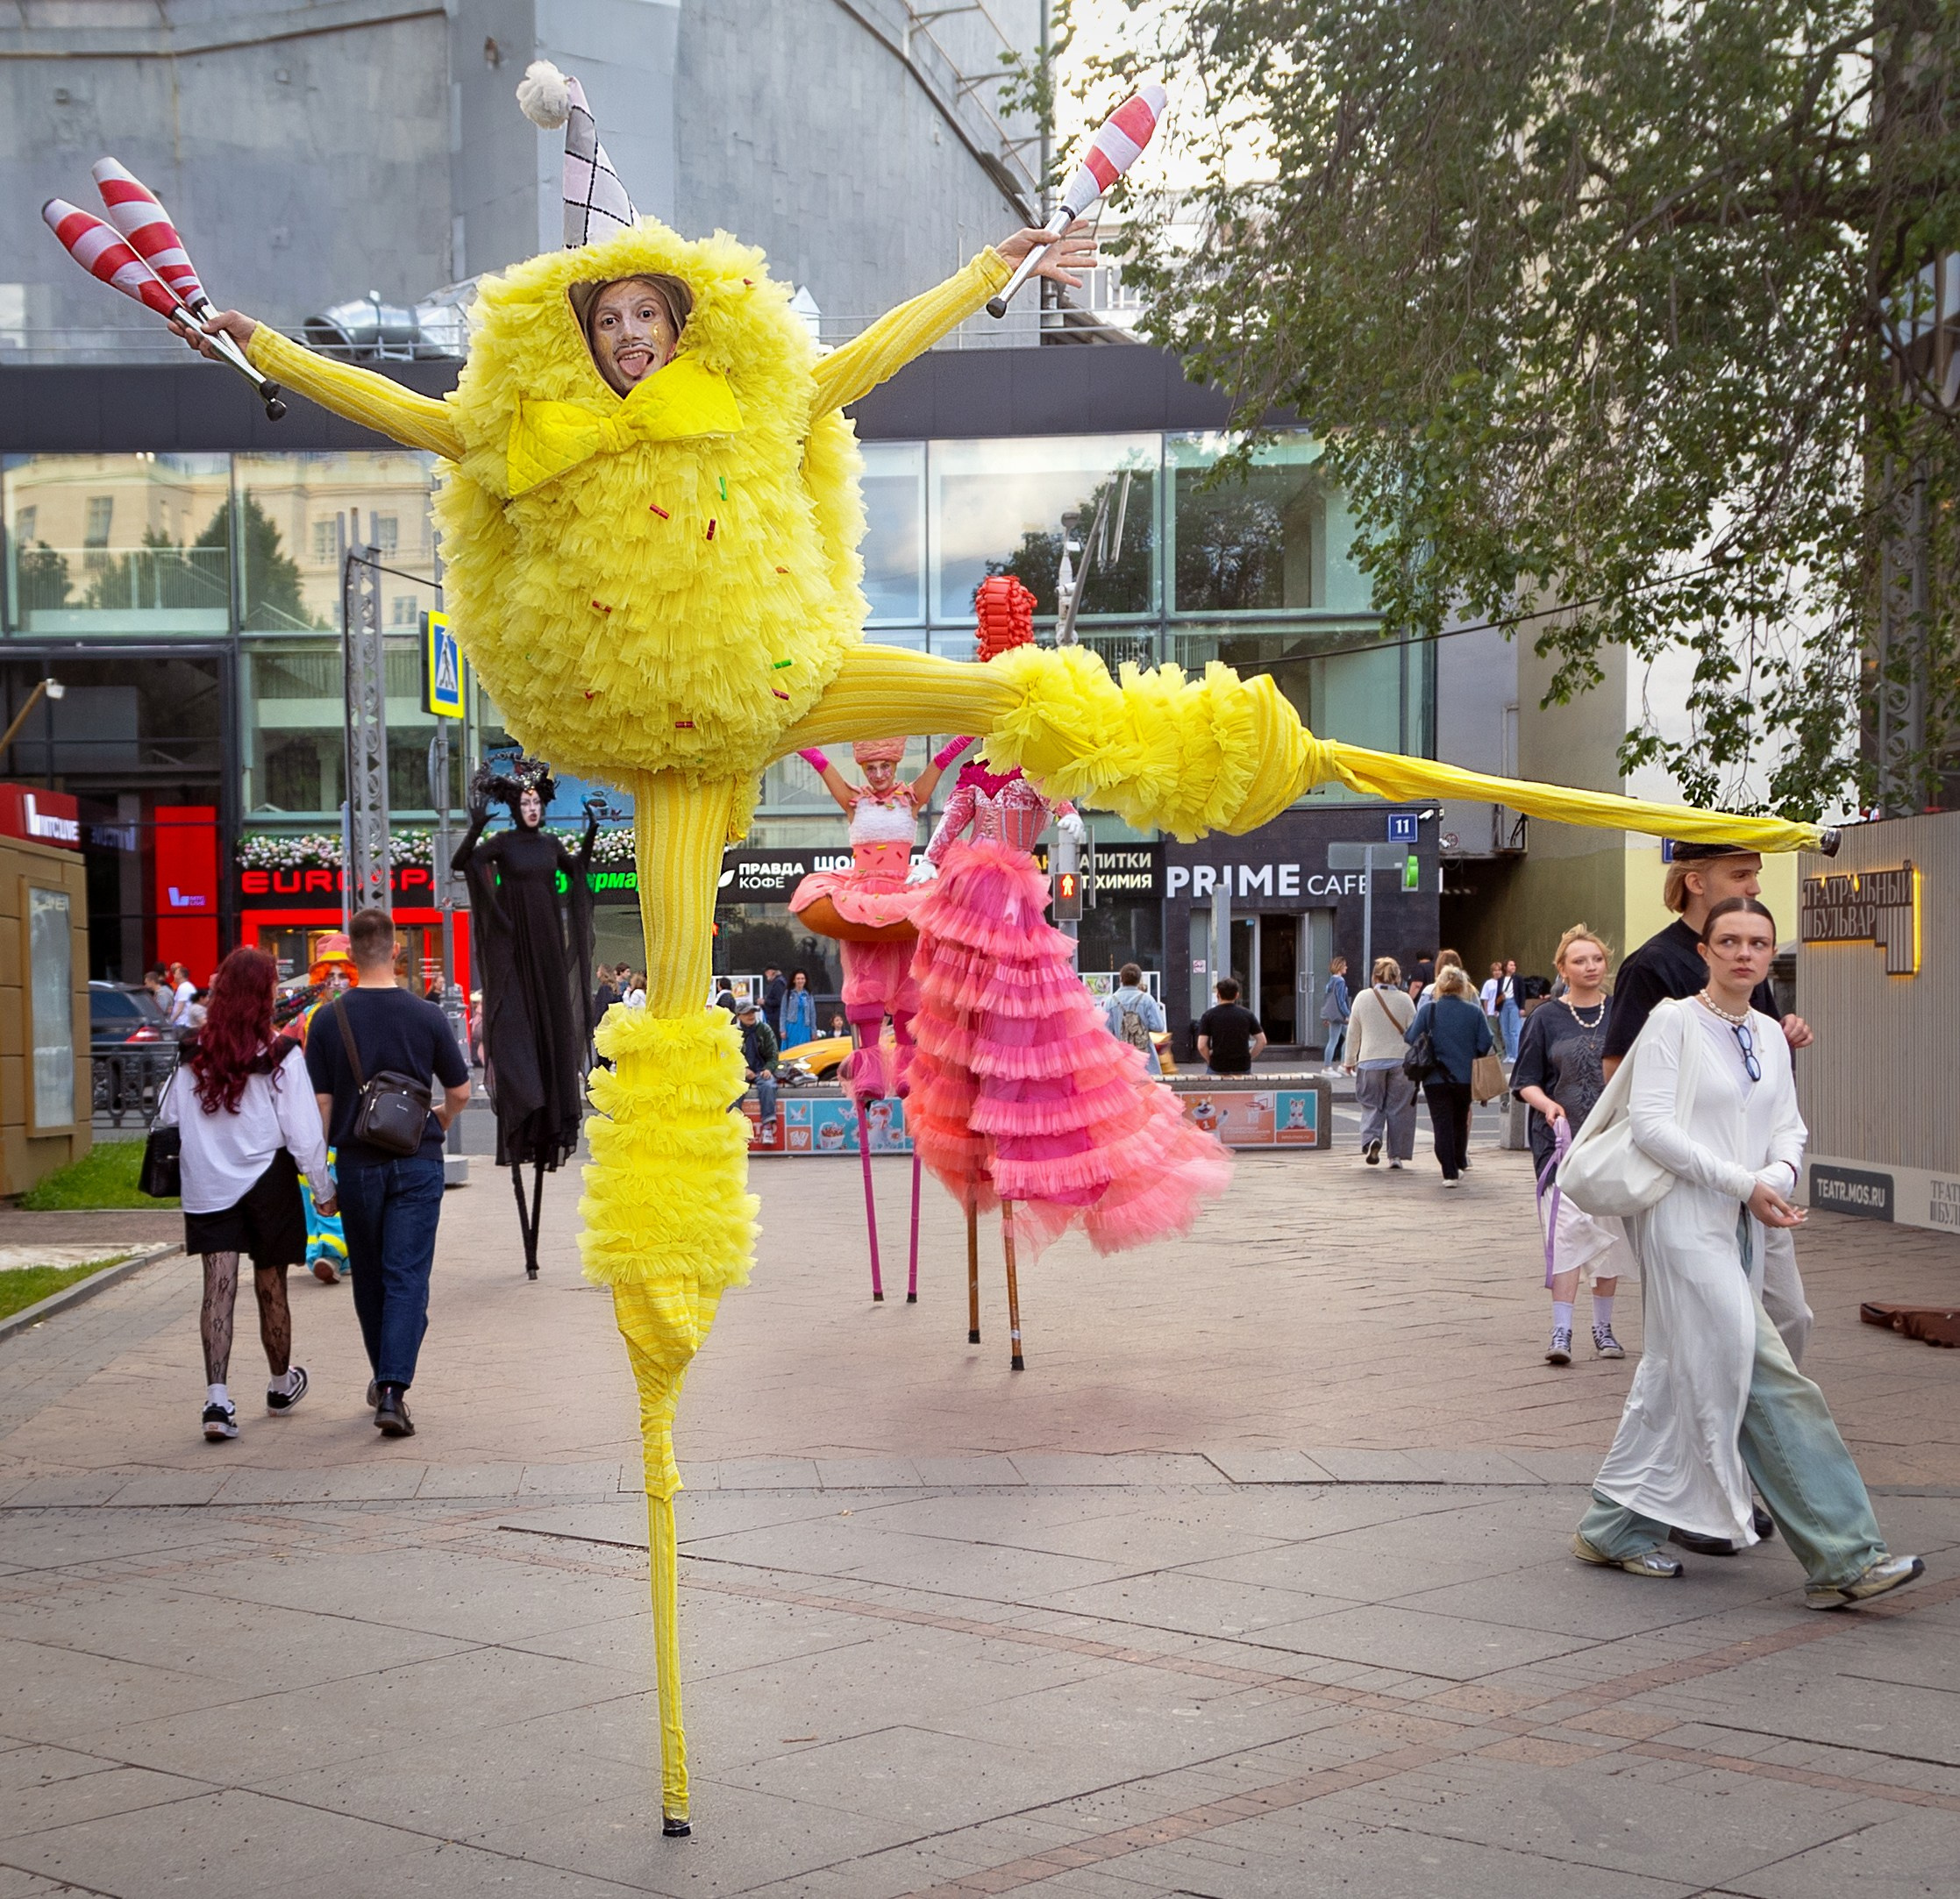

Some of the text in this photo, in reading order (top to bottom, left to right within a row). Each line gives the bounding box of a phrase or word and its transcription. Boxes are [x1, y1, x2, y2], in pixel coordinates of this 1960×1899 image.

[1395, 819, 1409, 834] 11
[738, 863, 805, 876] ПРАВДА
[1080, 853, 1151, 868] АПИТКИ
[739, 877, 786, 889] КОФЕ
[1166, 864, 1301, 898] PRIME
[1814, 905, 1877, 939] БУЛЬВАР
[1816, 1178, 1885, 1208] TEATR.MOS.RU
[1930, 1180, 1960, 1203] ТЕАТ
[1937, 1201, 1960, 1227] БУЛ
